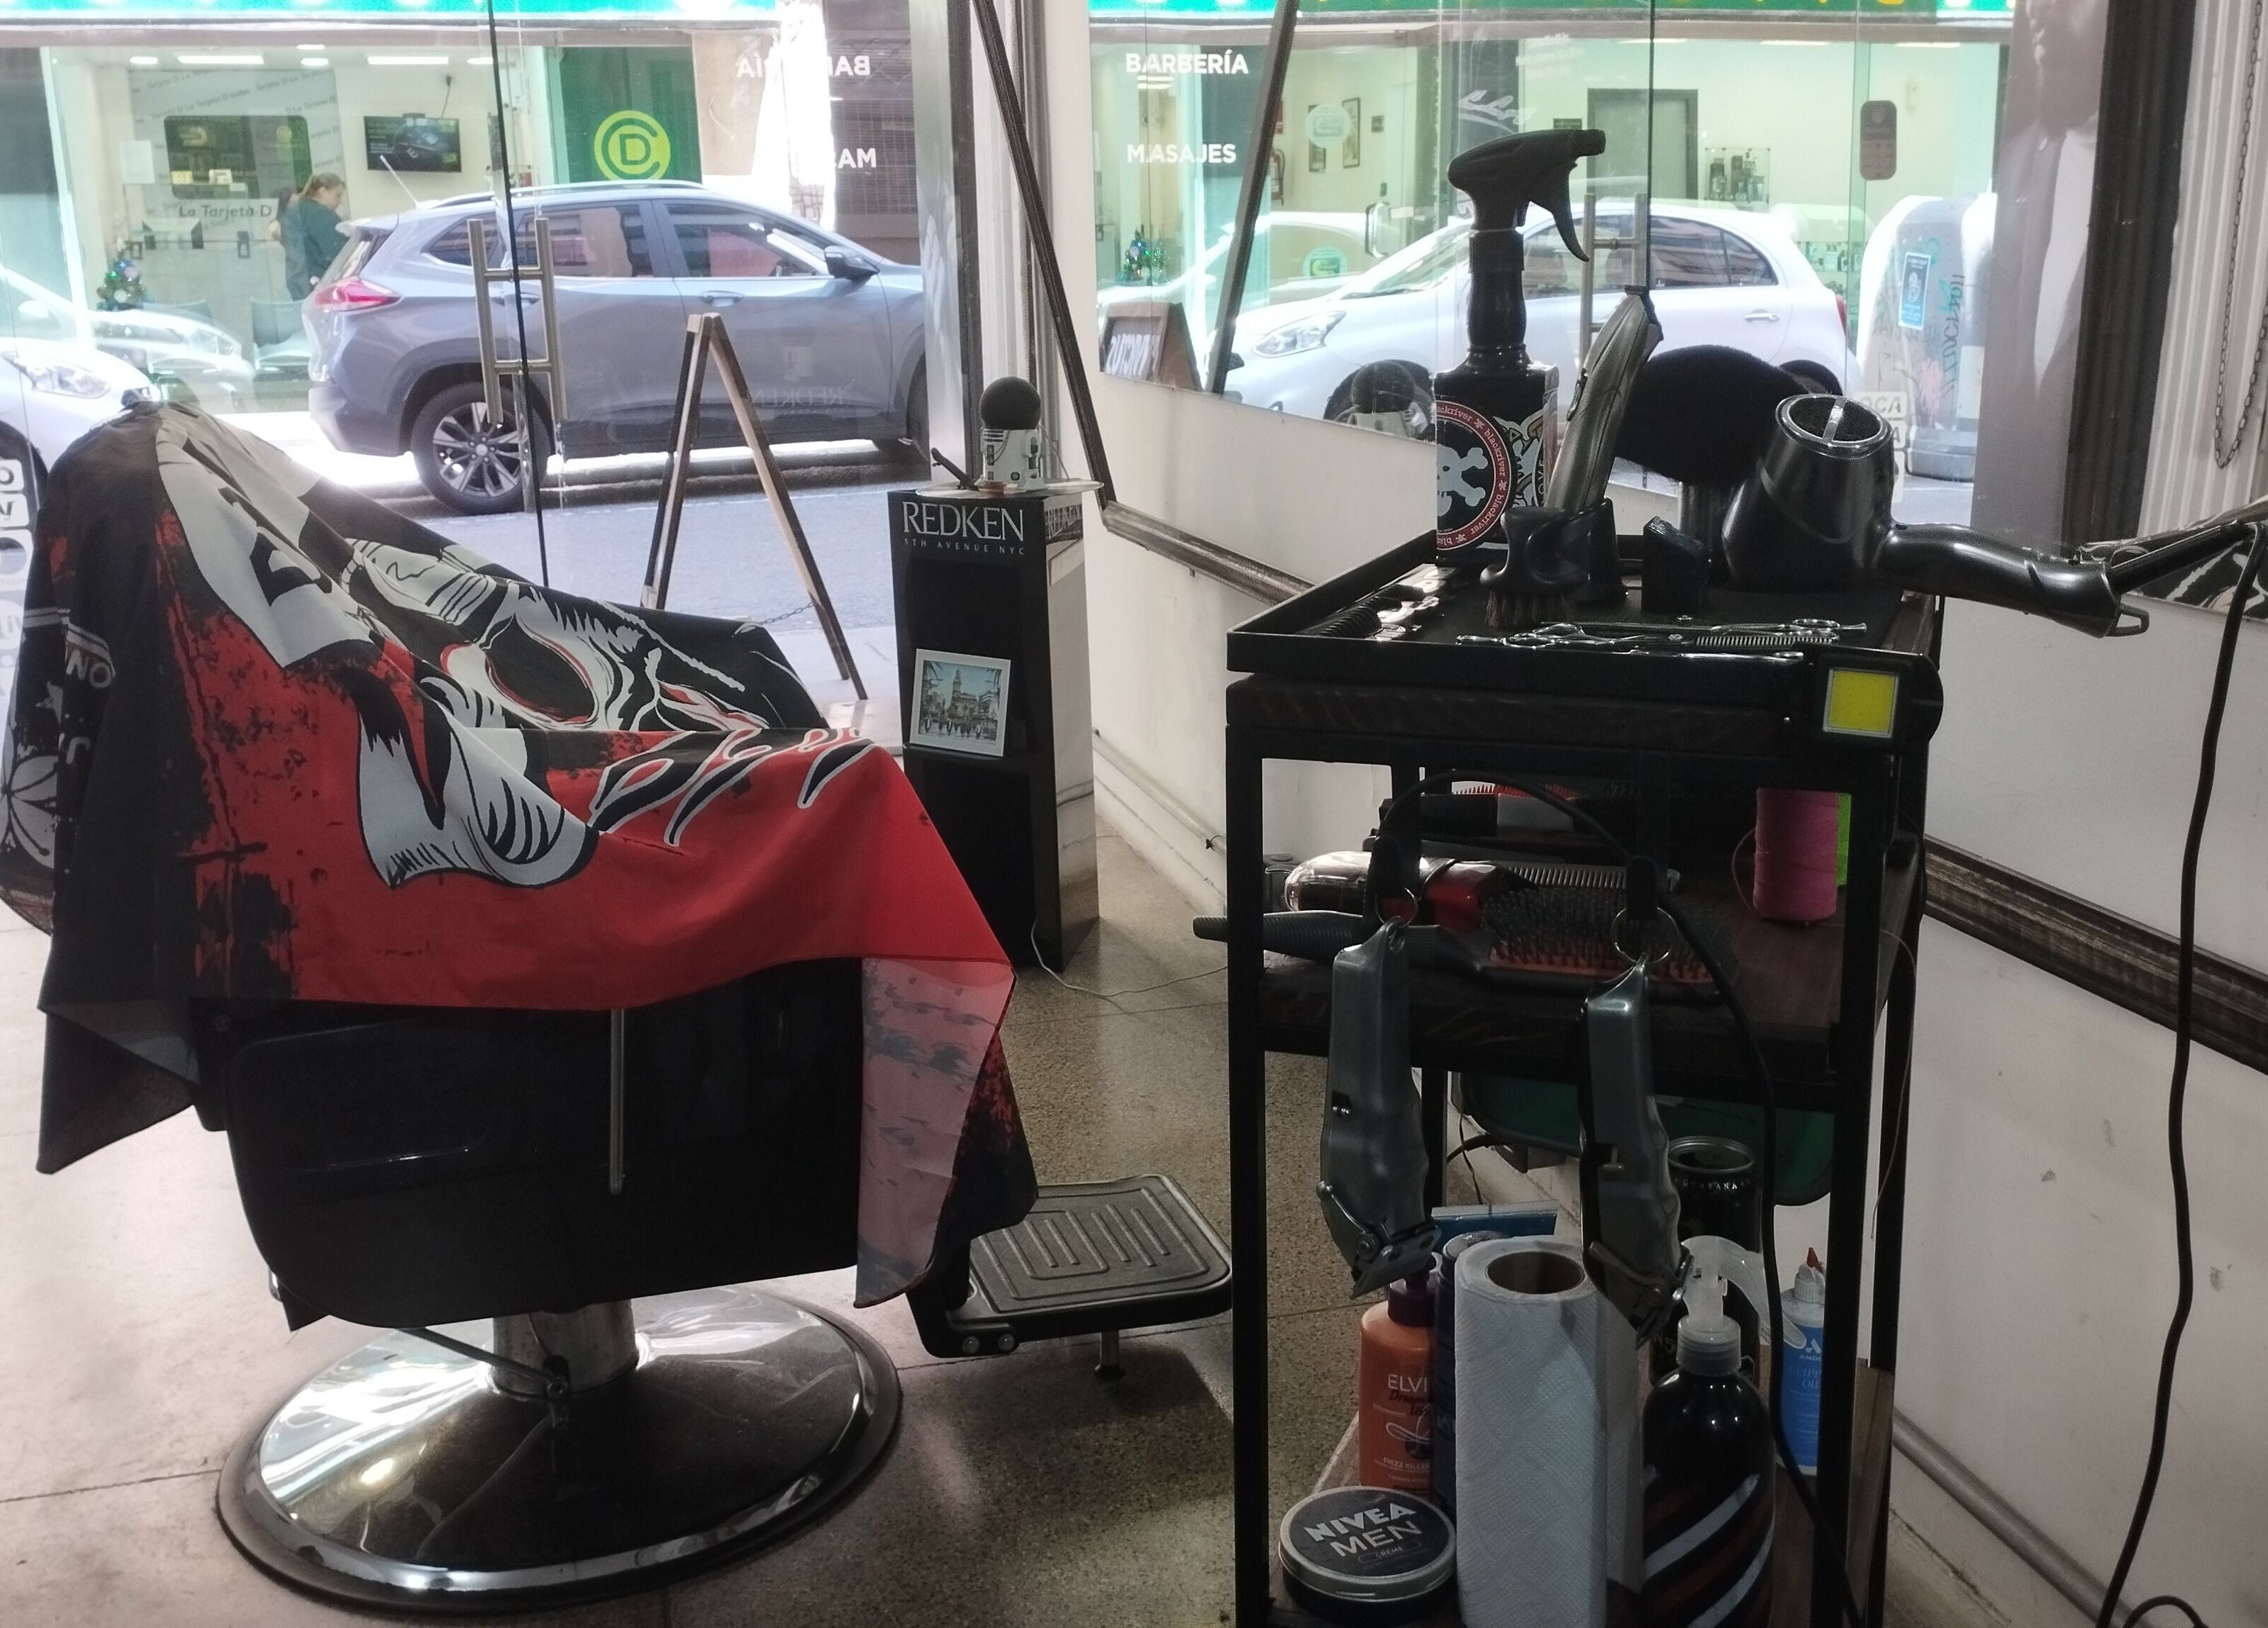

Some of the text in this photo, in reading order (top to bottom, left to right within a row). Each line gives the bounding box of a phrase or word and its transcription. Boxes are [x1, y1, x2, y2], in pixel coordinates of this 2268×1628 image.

[1125, 49, 1249, 74] BARBERÍA
[1127, 143, 1236, 164] MASAJES
[179, 204, 272, 219] La Tarjeta D
[902, 502, 1024, 542] REDKEN
[903, 538, 1025, 555] 5TH AVENUE NYC
[1788, 1366, 1822, 1378] CLIPP
[1387, 1373, 1428, 1393] ELVI
[1304, 1503, 1418, 1542] NIVEA
[1330, 1520, 1423, 1557] MEN
